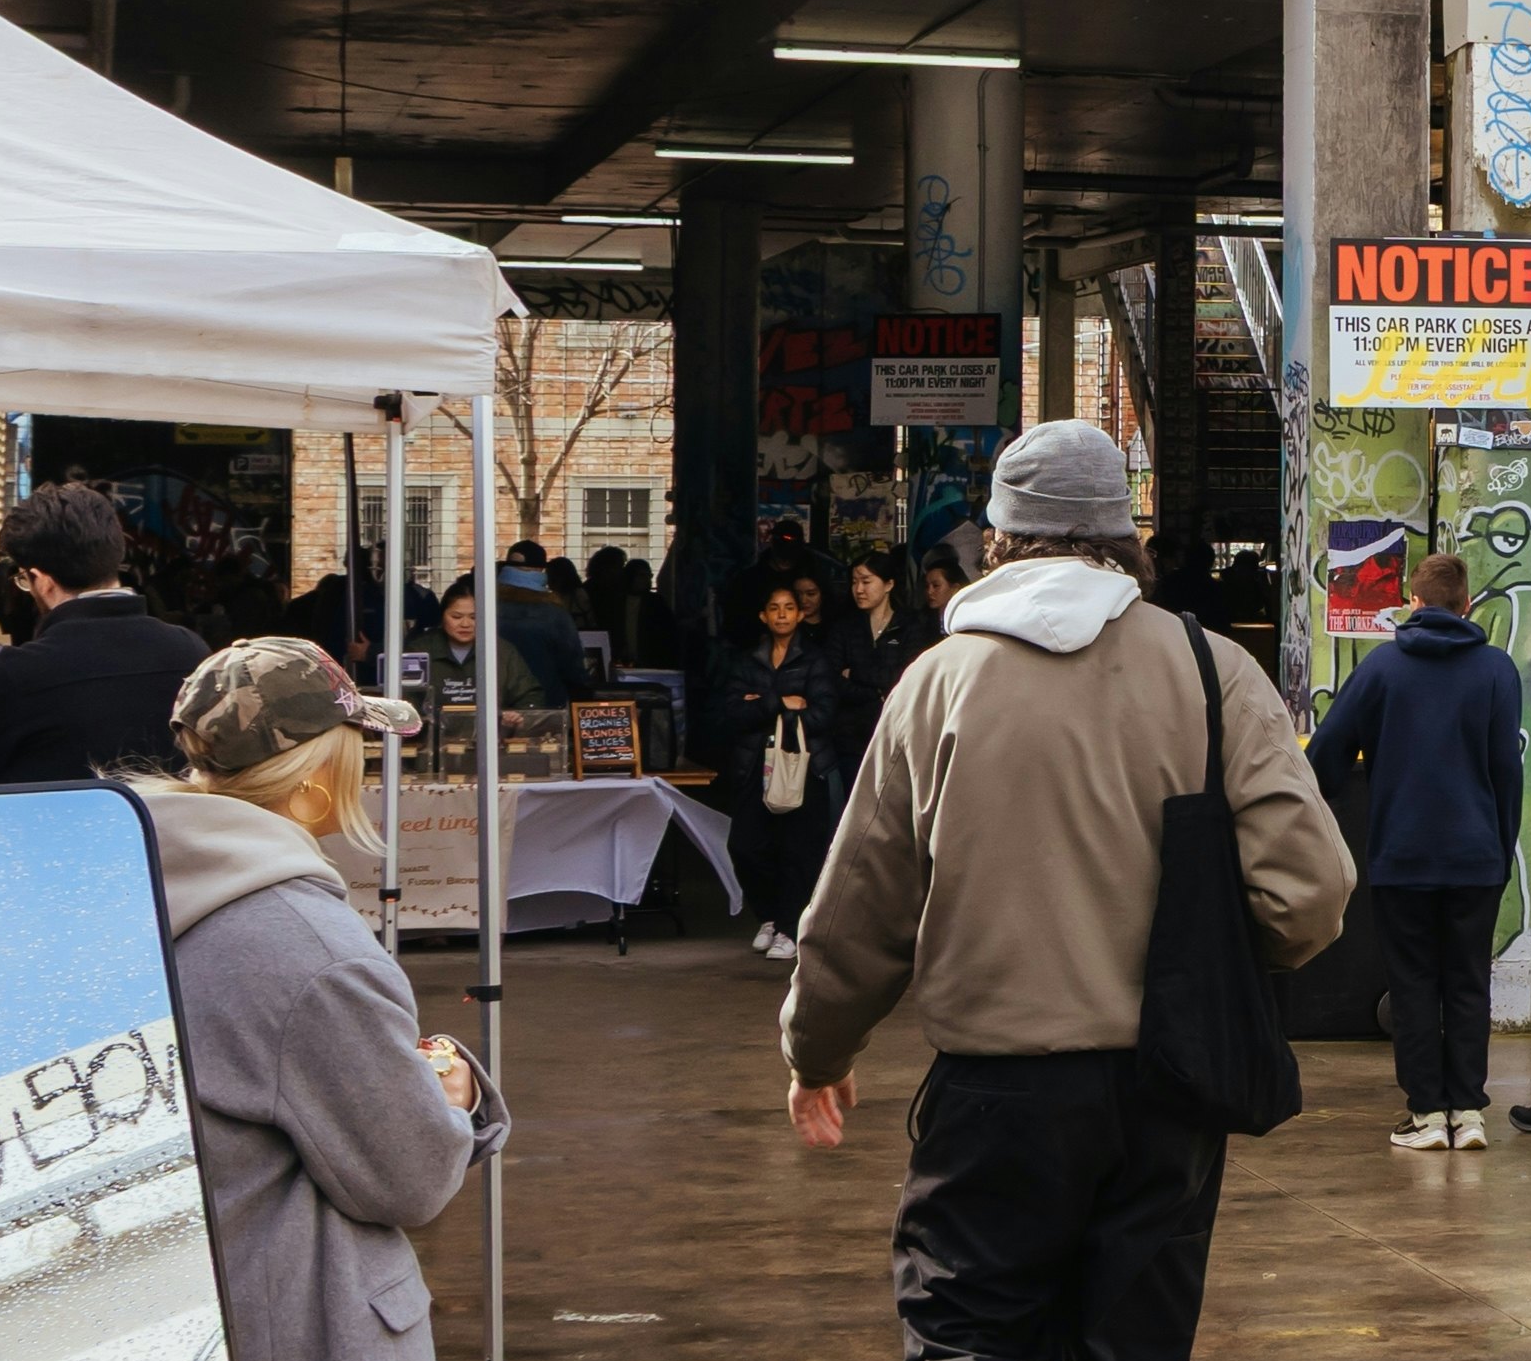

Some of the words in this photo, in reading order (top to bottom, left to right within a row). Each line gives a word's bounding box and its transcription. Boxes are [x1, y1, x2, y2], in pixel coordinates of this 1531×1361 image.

[1334, 316, 1371, 333] THIS
[1376, 317, 1410, 333] CAR
[1415, 318, 1457, 334] PARK
[1462, 318, 1522, 335] CLOSES
[877, 317, 996, 355] NOTICE
[1394, 337, 1420, 353] PM
[1426, 337, 1476, 353] EVERY
[1481, 338, 1529, 354] NIGHT
[874, 365, 896, 376] THIS
[899, 365, 919, 376] CAR
[921, 365, 947, 376] PARK
[949, 365, 984, 376] CLOSES
[985, 365, 997, 376] AT
[885, 377, 908, 389] 11:00
[909, 377, 925, 389] PM
[927, 377, 958, 389] EVERY
[959, 377, 987, 389] NIGHT
[578, 707, 627, 719] COOKIES
